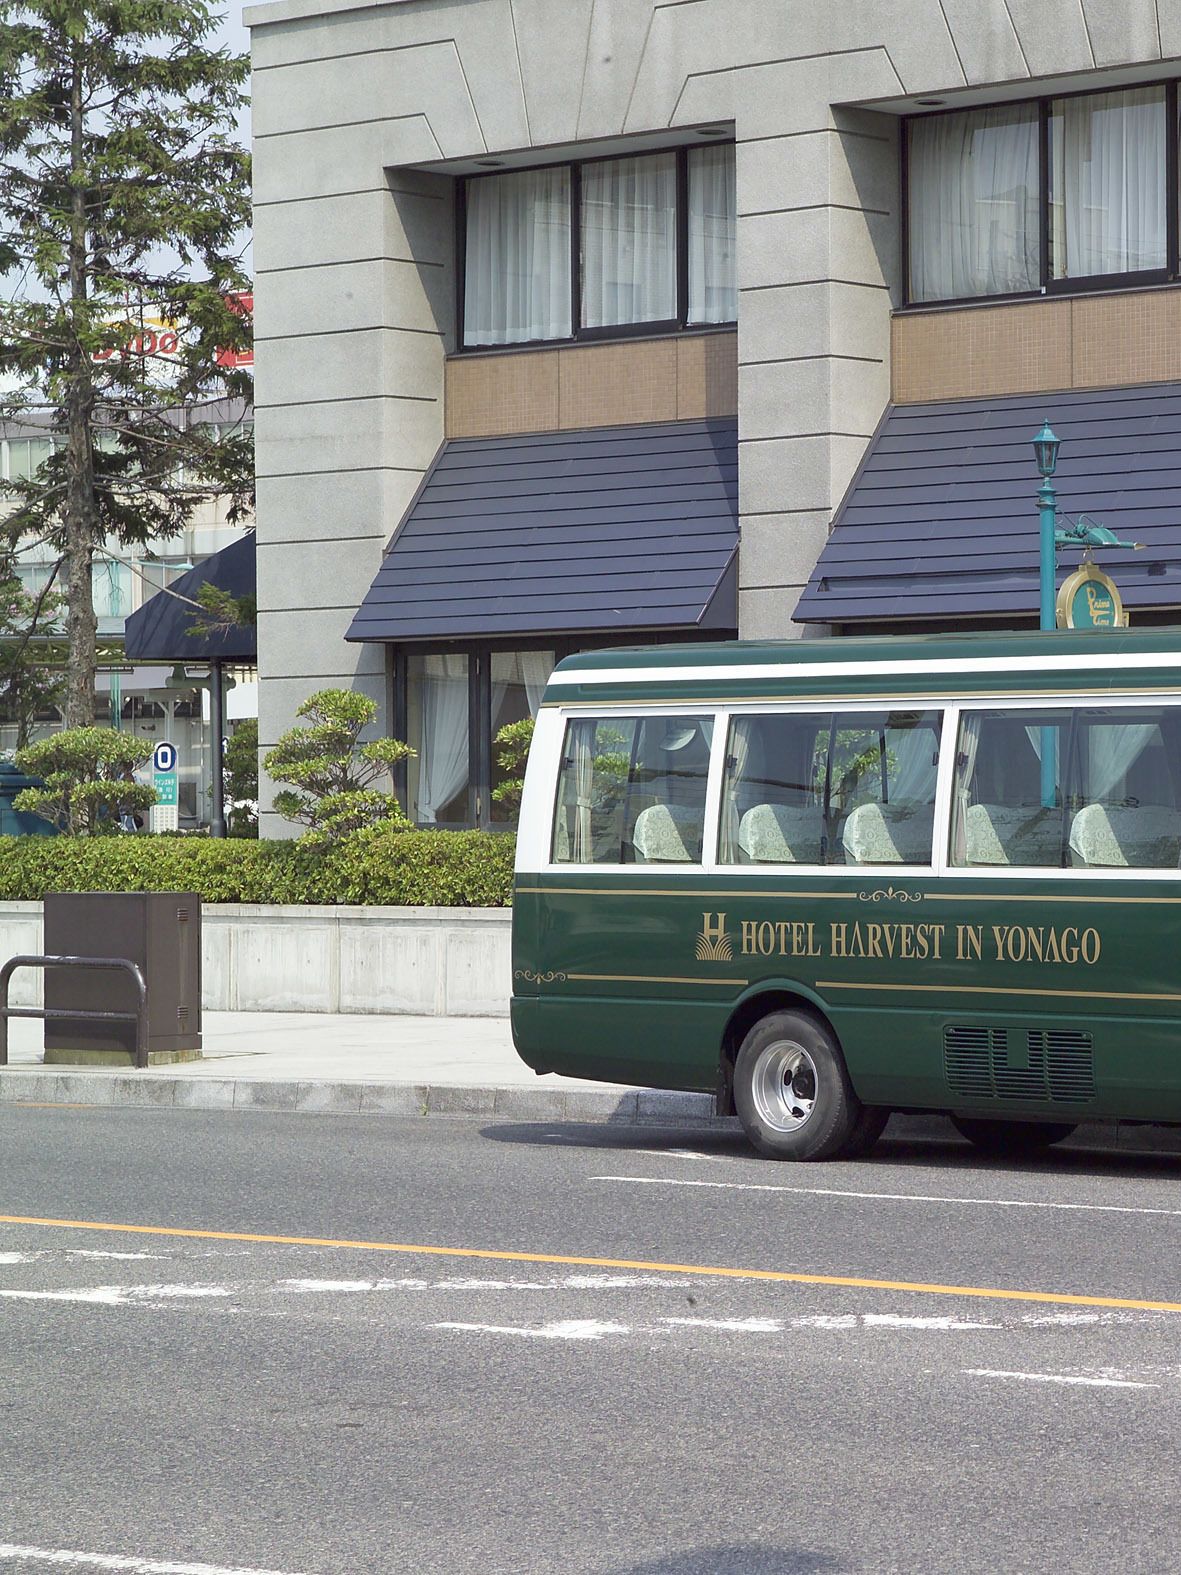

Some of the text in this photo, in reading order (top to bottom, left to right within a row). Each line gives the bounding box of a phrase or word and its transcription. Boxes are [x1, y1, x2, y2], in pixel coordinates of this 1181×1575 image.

[740, 920, 1101, 965] HOTEL HARVEST IN YONAGO
